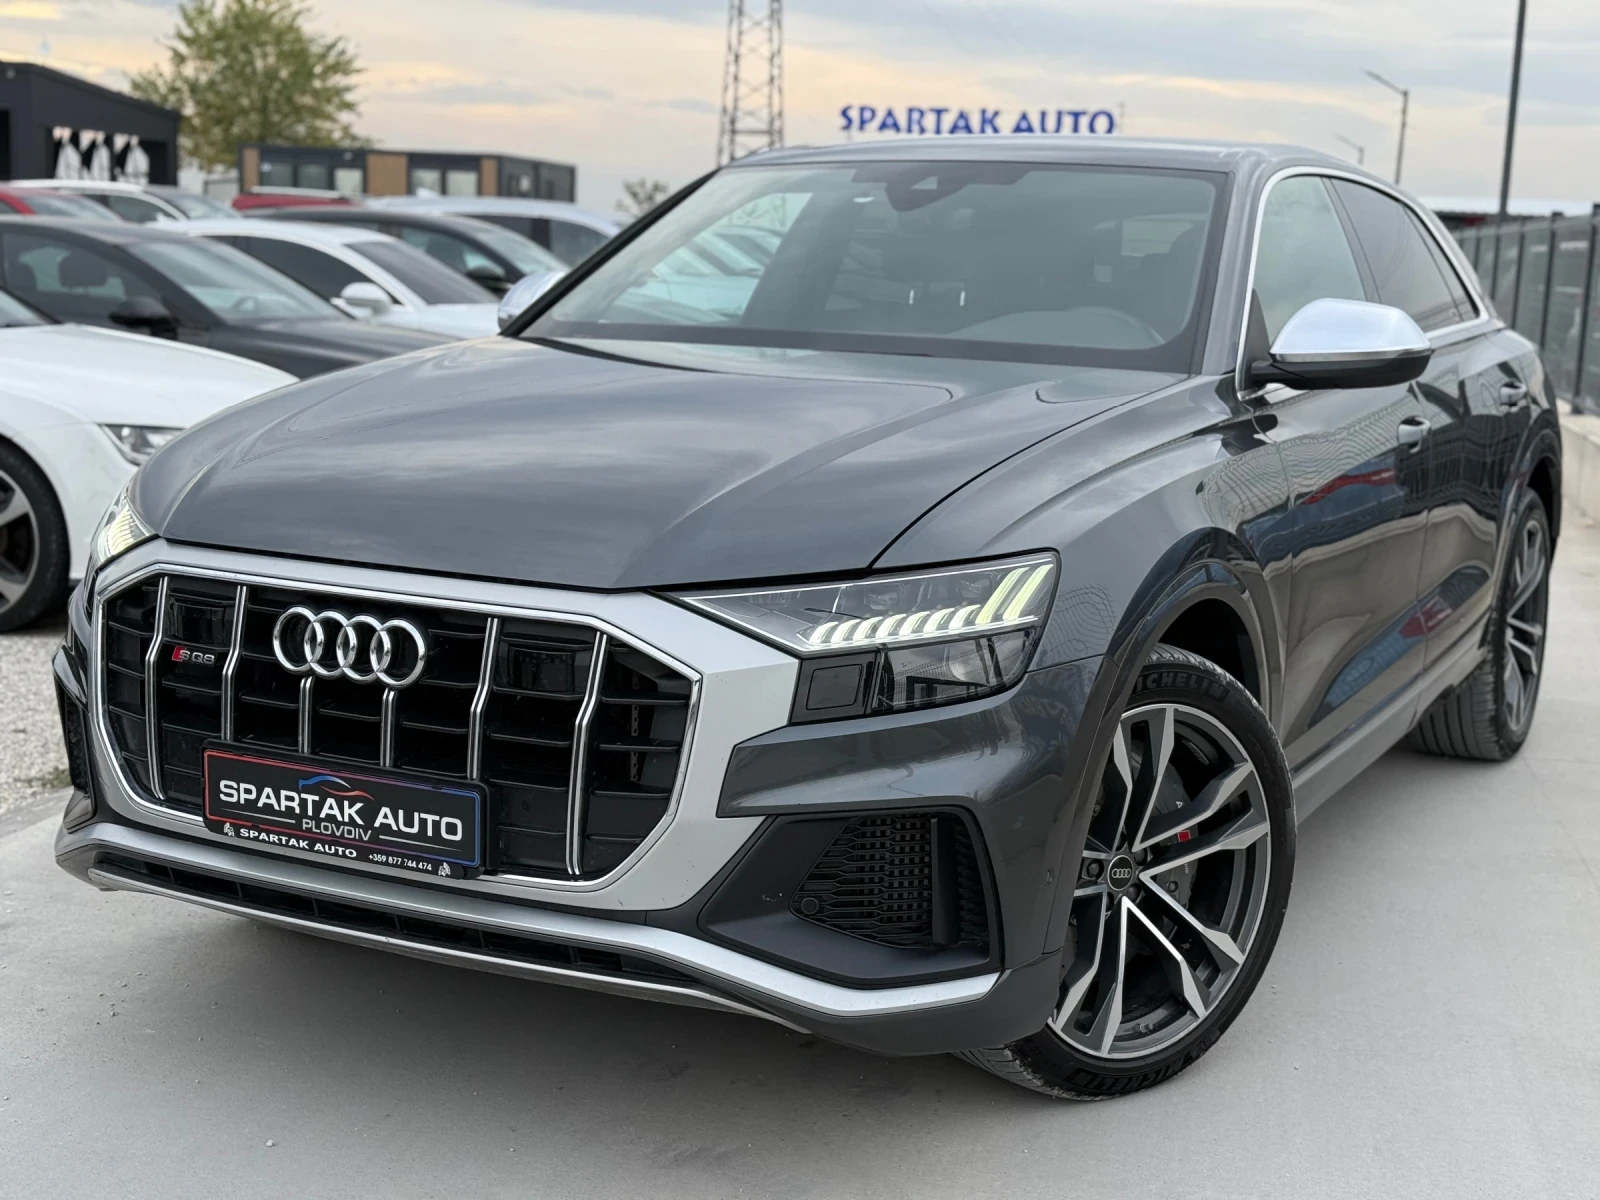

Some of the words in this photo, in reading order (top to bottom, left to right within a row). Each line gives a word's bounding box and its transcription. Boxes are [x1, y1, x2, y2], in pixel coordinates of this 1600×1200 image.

[839, 105, 1001, 135] SPARTAK
[1011, 110, 1115, 134] AUTO
[1136, 672, 1225, 699] ICHELIN
[219, 779, 365, 826] SPARTAK
[373, 806, 463, 841] AUTO
[302, 818, 372, 841] PLOVDIV
[239, 828, 310, 849] SPARTAK
[313, 842, 357, 858] AUTO
[368, 853, 386, 862] +359
[388, 856, 402, 865] 877
[404, 858, 416, 868] 744
[418, 861, 432, 871] 474
